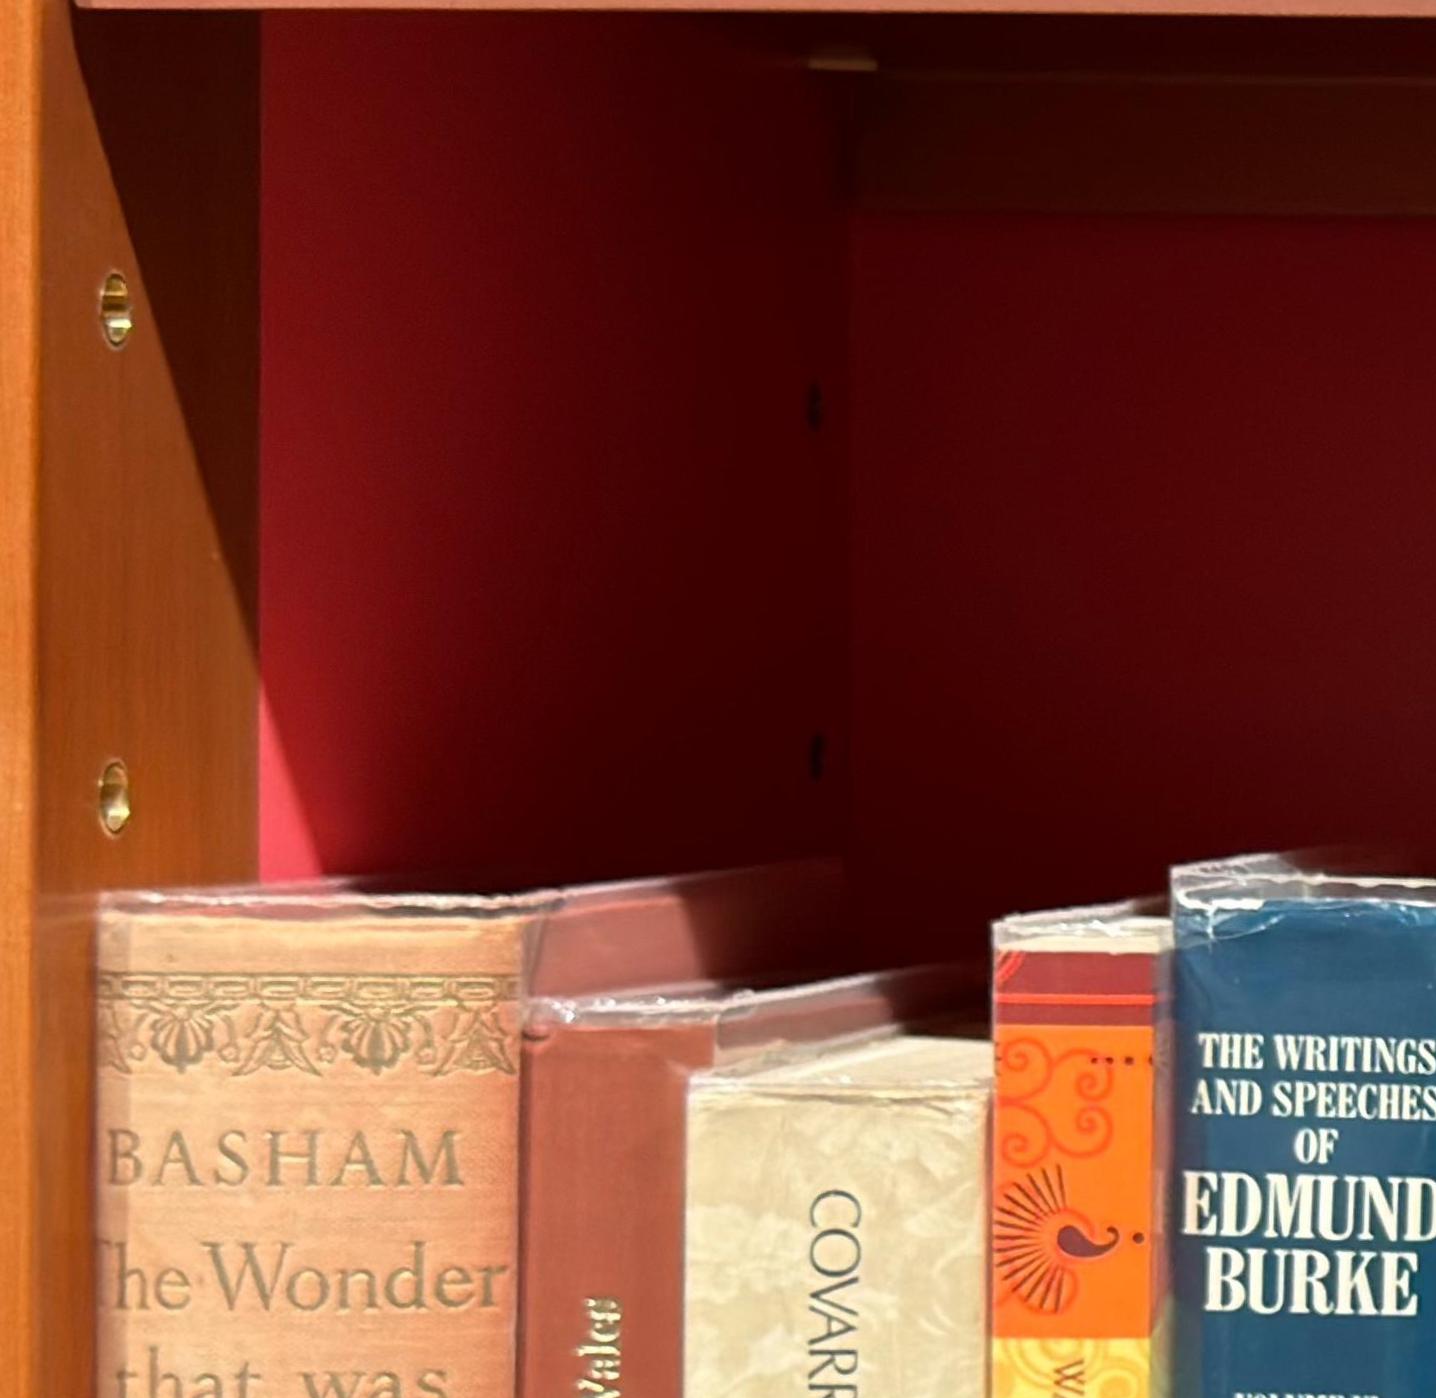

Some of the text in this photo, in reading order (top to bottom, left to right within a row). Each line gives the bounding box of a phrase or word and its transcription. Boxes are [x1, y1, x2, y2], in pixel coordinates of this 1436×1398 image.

[1198, 1033, 1264, 1070] THE
[1191, 1078, 1263, 1117] AND
[107, 1129, 466, 1188] BASHAM
[1294, 1128, 1339, 1165] OF
[201, 1240, 511, 1314] Wonder
[1204, 1246, 1420, 1318] BURKE
